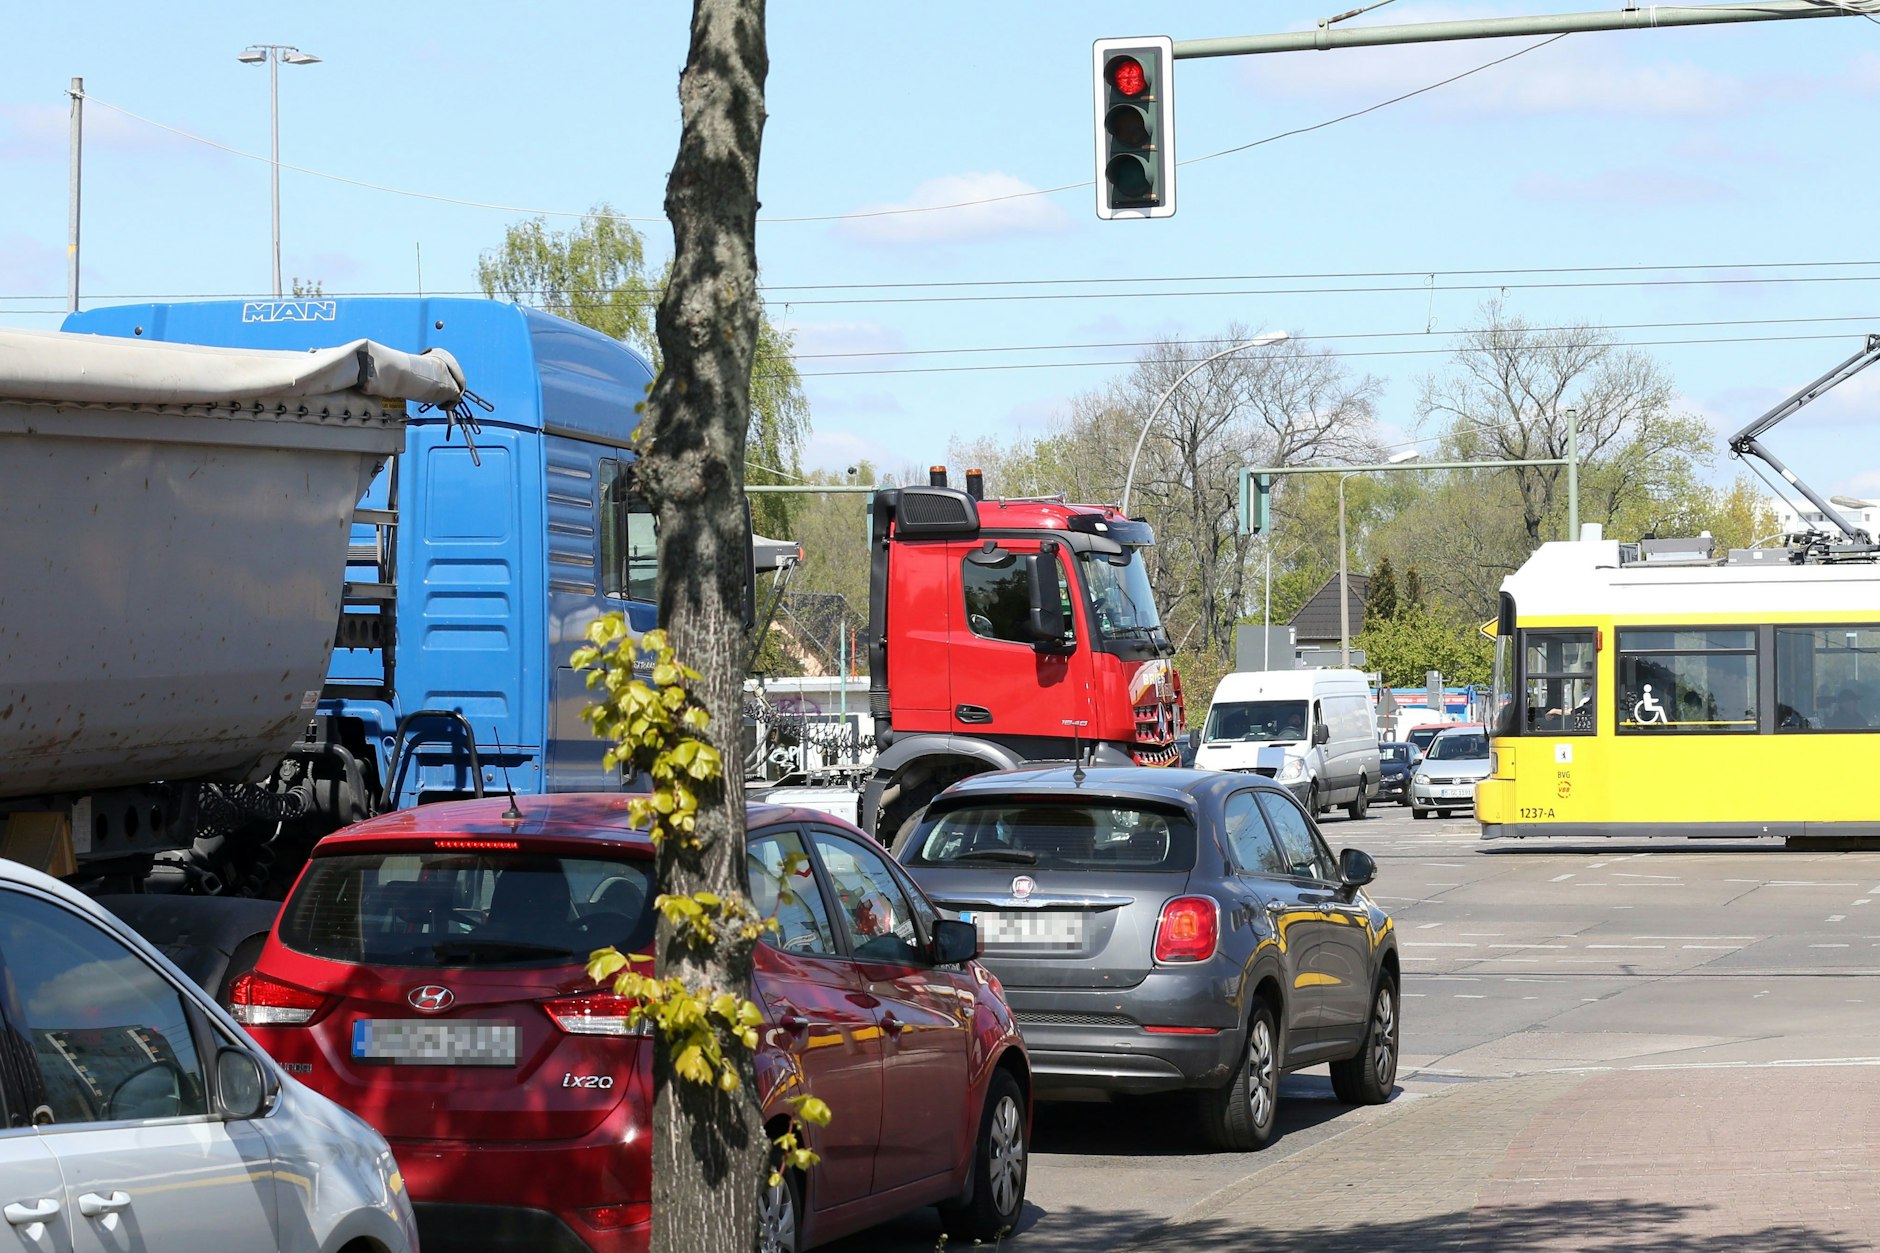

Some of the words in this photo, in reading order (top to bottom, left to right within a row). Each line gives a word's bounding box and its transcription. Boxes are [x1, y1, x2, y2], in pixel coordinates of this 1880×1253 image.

[242, 301, 337, 323] MAN
[1520, 808, 1555, 819] 1237-A
[562, 1072, 614, 1089] ix20
